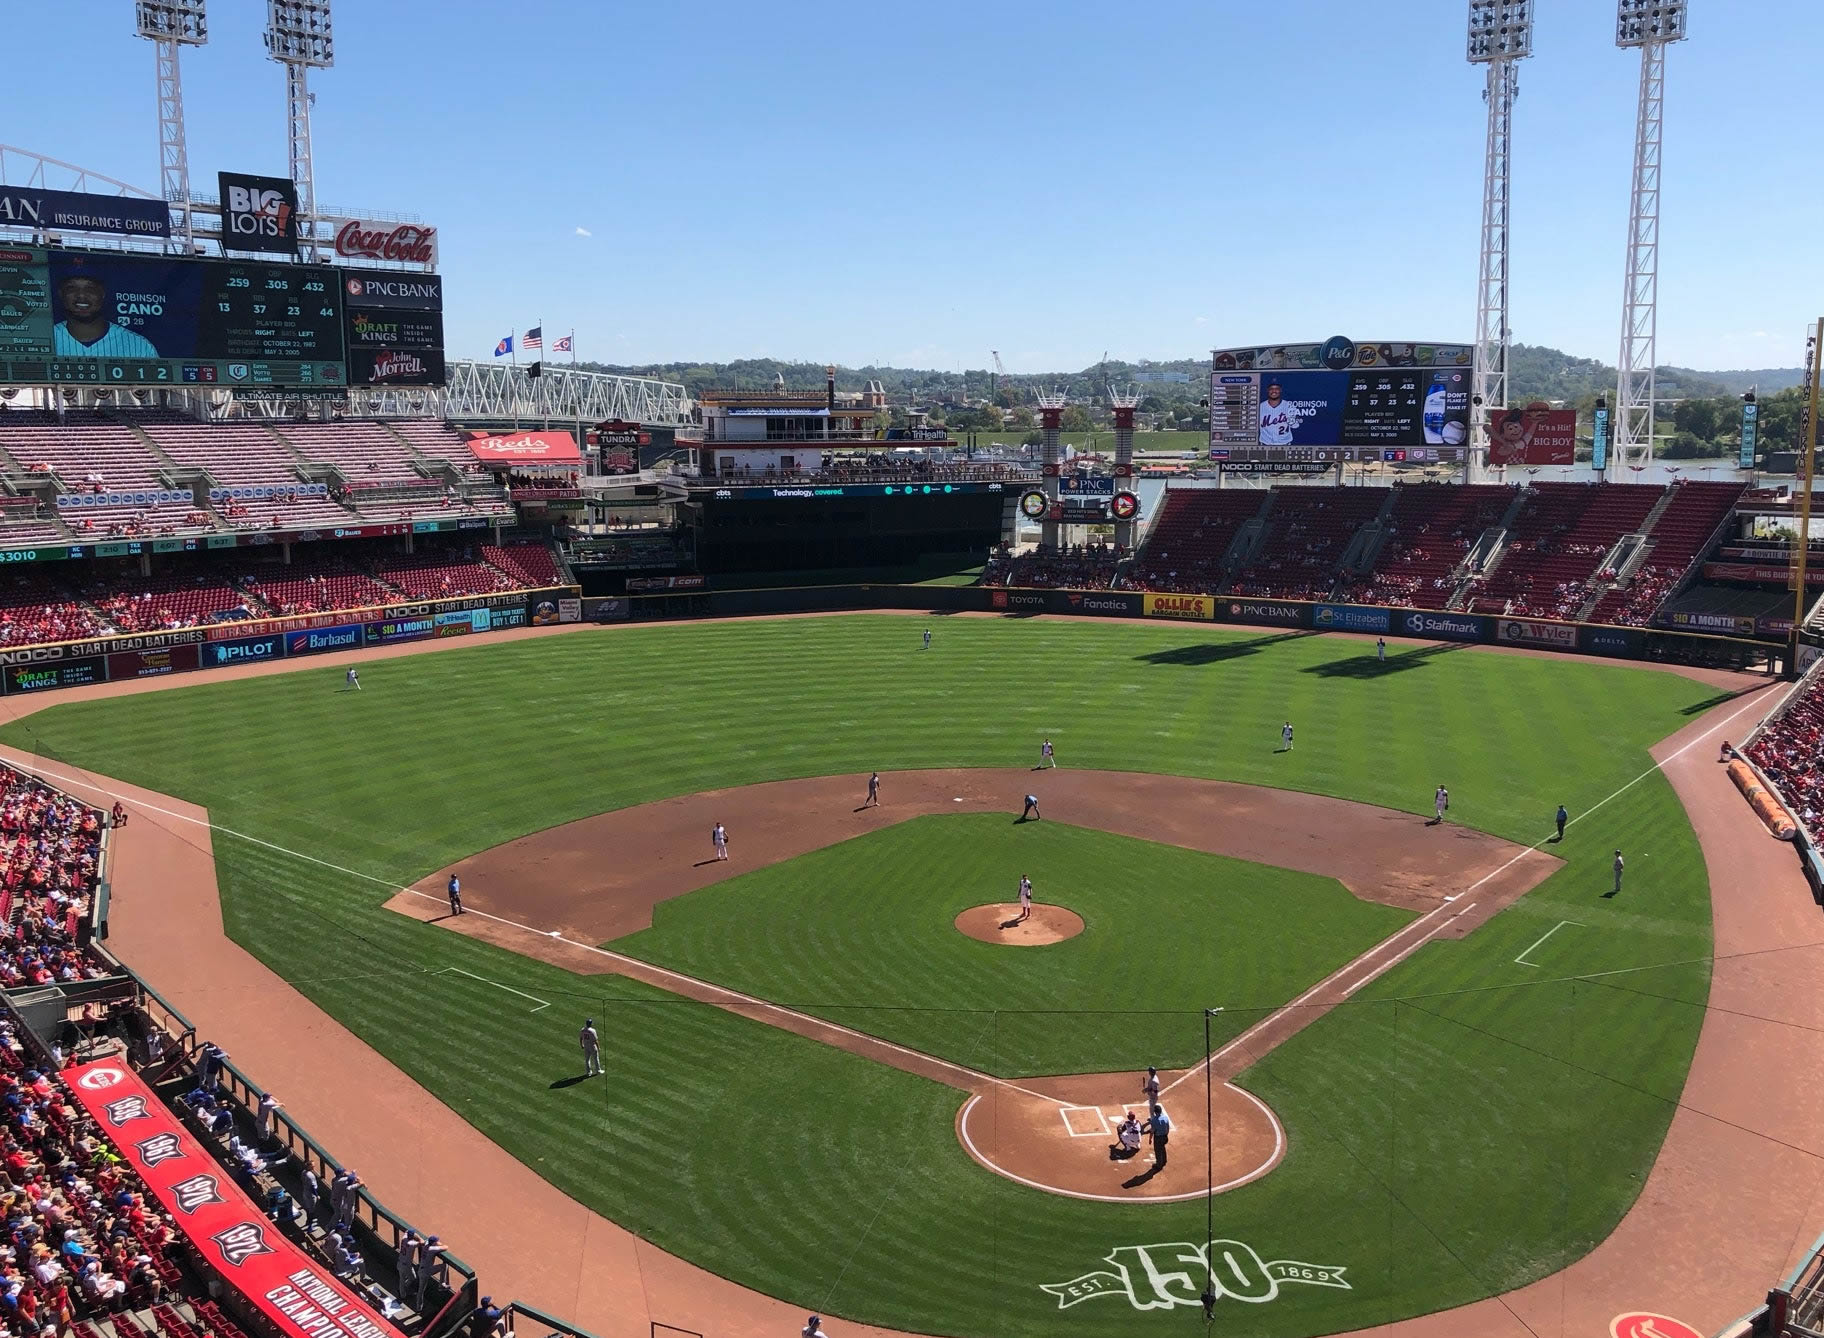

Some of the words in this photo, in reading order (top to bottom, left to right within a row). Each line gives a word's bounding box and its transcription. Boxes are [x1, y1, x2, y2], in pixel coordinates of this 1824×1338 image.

[228, 185, 283, 215] BIG
[54, 213, 122, 229] INSURANCE
[125, 219, 163, 232] GROUP
[230, 203, 291, 238] LOTS!
[336, 220, 437, 263] Coca-Cola
[226, 277, 250, 288] .259
[264, 280, 289, 290] .305
[302, 282, 324, 292] .432
[115, 292, 166, 303] ROBINSON
[218, 303, 230, 312] 13
[253, 304, 266, 314] 37
[287, 306, 300, 316] 23
[320, 308, 333, 317] 44
[355, 322, 398, 333] DRAFT
[361, 332, 397, 341] KINGS
[388, 351, 411, 363] John
[1327, 346, 1352, 359] P&G
[1358, 349, 1377, 363] Tide
[112, 367, 123, 379] 0
[138, 367, 144, 379] 1
[157, 367, 167, 380] 2
[368, 358, 427, 381] Morrell
[189, 372, 196, 381] 5
[206, 372, 213, 381] 5
[236, 392, 283, 400] ULTIMATE
[284, 392, 300, 400] AIR
[1287, 400, 1327, 408] ROBINSON
[1261, 412, 1288, 428] Mets
[600, 435, 636, 443] TUNDRA
[911, 430, 947, 439] TriHealth
[480, 436, 551, 452] Reds
[1533, 437, 1550, 446] BIG
[1552, 437, 1572, 446] BOY
[1221, 463, 1252, 471] NOCO
[1292, 464, 1326, 472] BATTERIES.
[1079, 479, 1105, 490] PNC
[559, 489, 577, 498] PATIO
[716, 489, 731, 497] cbts
[772, 489, 814, 498] Technology,
[814, 488, 843, 496] covered.
[0, 550, 37, 562] $3010
[1755, 570, 1771, 578] THIS
[1773, 571, 1795, 579] BUD'S
[384, 605, 430, 619] NOCO
[435, 603, 461, 613] START
[463, 599, 485, 610] DEAD
[487, 593, 529, 608] BATTERIES.
[1010, 596, 1045, 605] TOYOTA
[1083, 598, 1127, 610] Fanatics
[444, 613, 471, 623] TriHealth
[1151, 609, 1180, 617] BARGAIN
[1345, 612, 1388, 624] Elizabeth
[211, 624, 266, 640] ULTRASAFE
[269, 618, 307, 633] LITHIUM
[310, 616, 334, 628] JUMP
[336, 611, 383, 625] STARTERS.
[382, 624, 395, 634] $10
[396, 623, 403, 633] A
[403, 619, 433, 632] MONTH
[492, 617, 504, 627] BUY
[510, 616, 520, 625] GET
[1425, 619, 1478, 635] Staffmark
[1673, 614, 1688, 623] $10
[1689, 615, 1697, 625] A
[1698, 615, 1735, 628] MONTH
[1529, 623, 1573, 641] Wyler
[310, 631, 357, 648] Barbasol
[1601, 637, 1626, 645] DELTA
[1, 647, 64, 665] NOCO
[71, 641, 109, 657] START
[112, 638, 143, 652] DEAD
[146, 630, 206, 648] BATTERIES.
[227, 642, 273, 658] PILOT
[16, 670, 58, 684] DRAFT
[22, 677, 58, 689] KINGS
[109, 1096, 142, 1124] 1939
[142, 1135, 177, 1165] 1961
[176, 1175, 213, 1207] 1970
[222, 1223, 262, 1259] 1972
[1103, 1239, 1279, 1311] 150
[1276, 1265, 1331, 1281] 1869
[287, 1268, 352, 1315] NATIONAL
[1067, 1278, 1111, 1297] EST.
